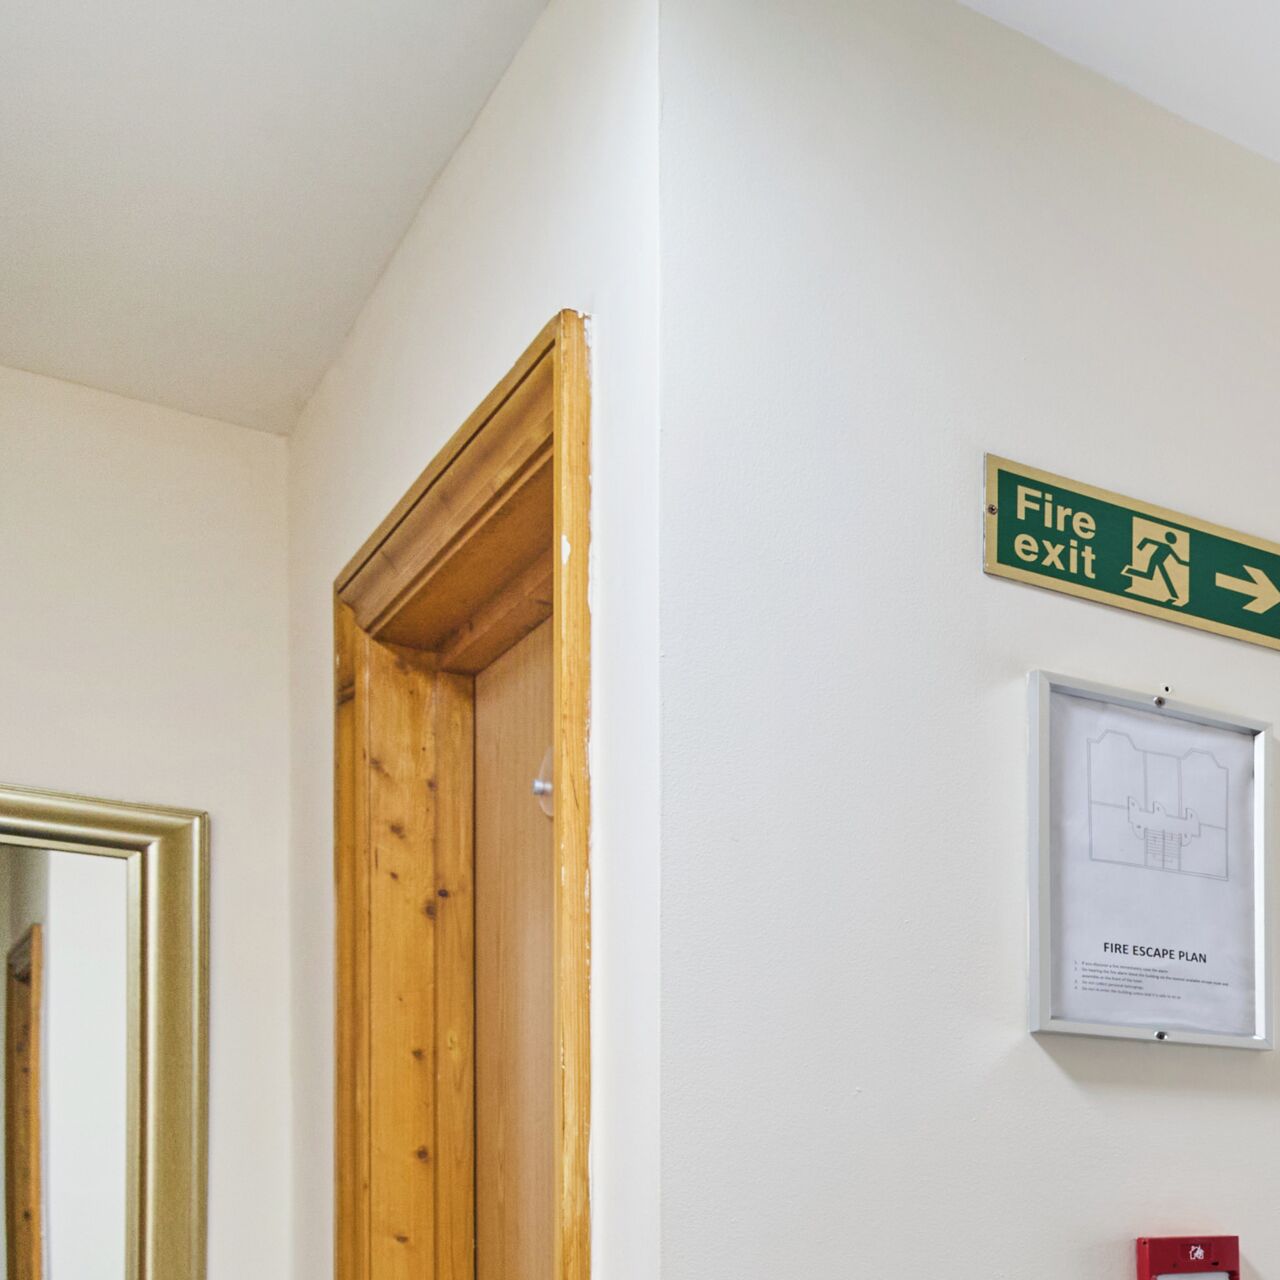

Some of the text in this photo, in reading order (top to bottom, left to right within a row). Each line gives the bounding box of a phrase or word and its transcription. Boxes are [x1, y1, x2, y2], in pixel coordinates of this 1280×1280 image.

[1016, 484, 1096, 540] Fire
[1014, 533, 1096, 580] exit
[1103, 942, 1207, 963] FIRE ESCAPE PLAN
